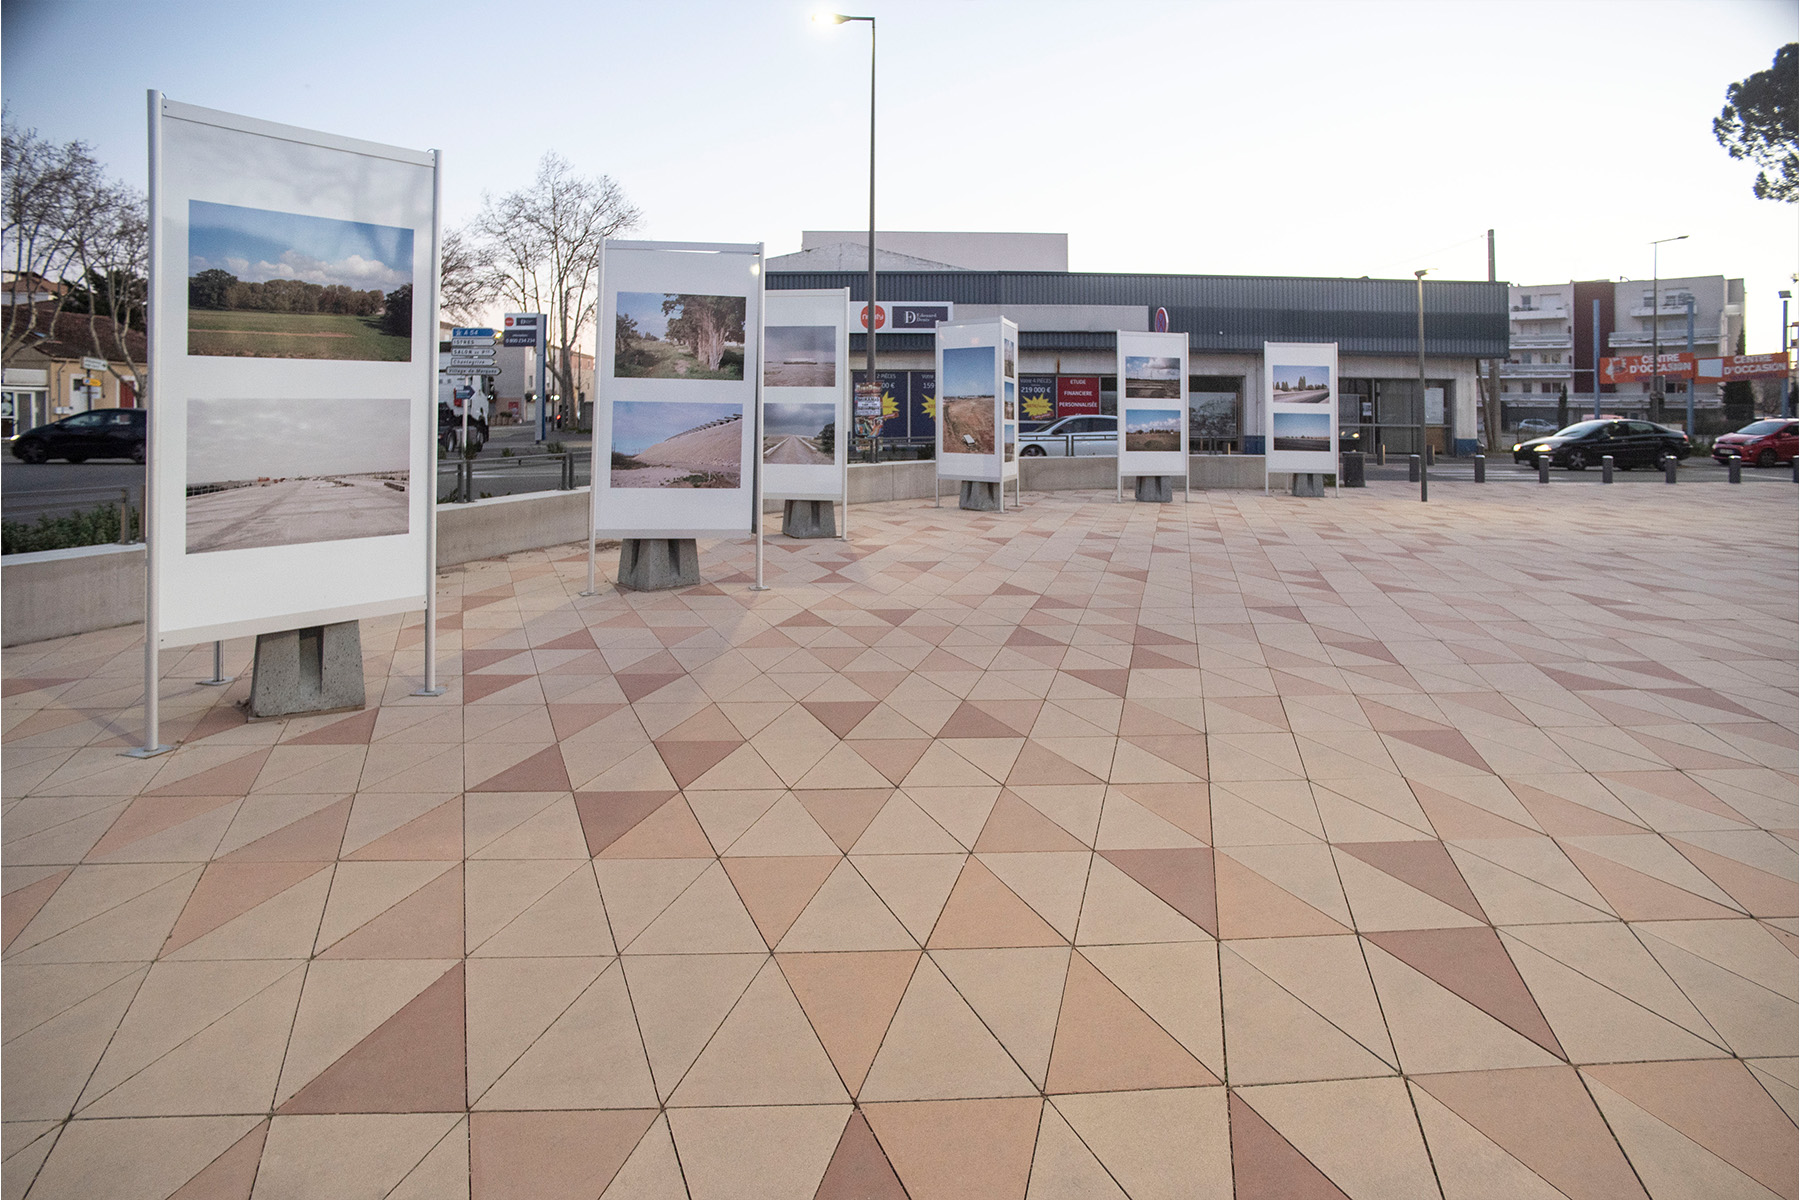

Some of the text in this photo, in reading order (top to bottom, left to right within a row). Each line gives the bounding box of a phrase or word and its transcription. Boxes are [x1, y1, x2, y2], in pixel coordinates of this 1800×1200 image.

[1642, 354, 1680, 364] CENTRE
[1734, 354, 1773, 364] CENTRE
[1630, 362, 1692, 374] D'OCCASION
[1724, 362, 1786, 375] D'OCCASION
